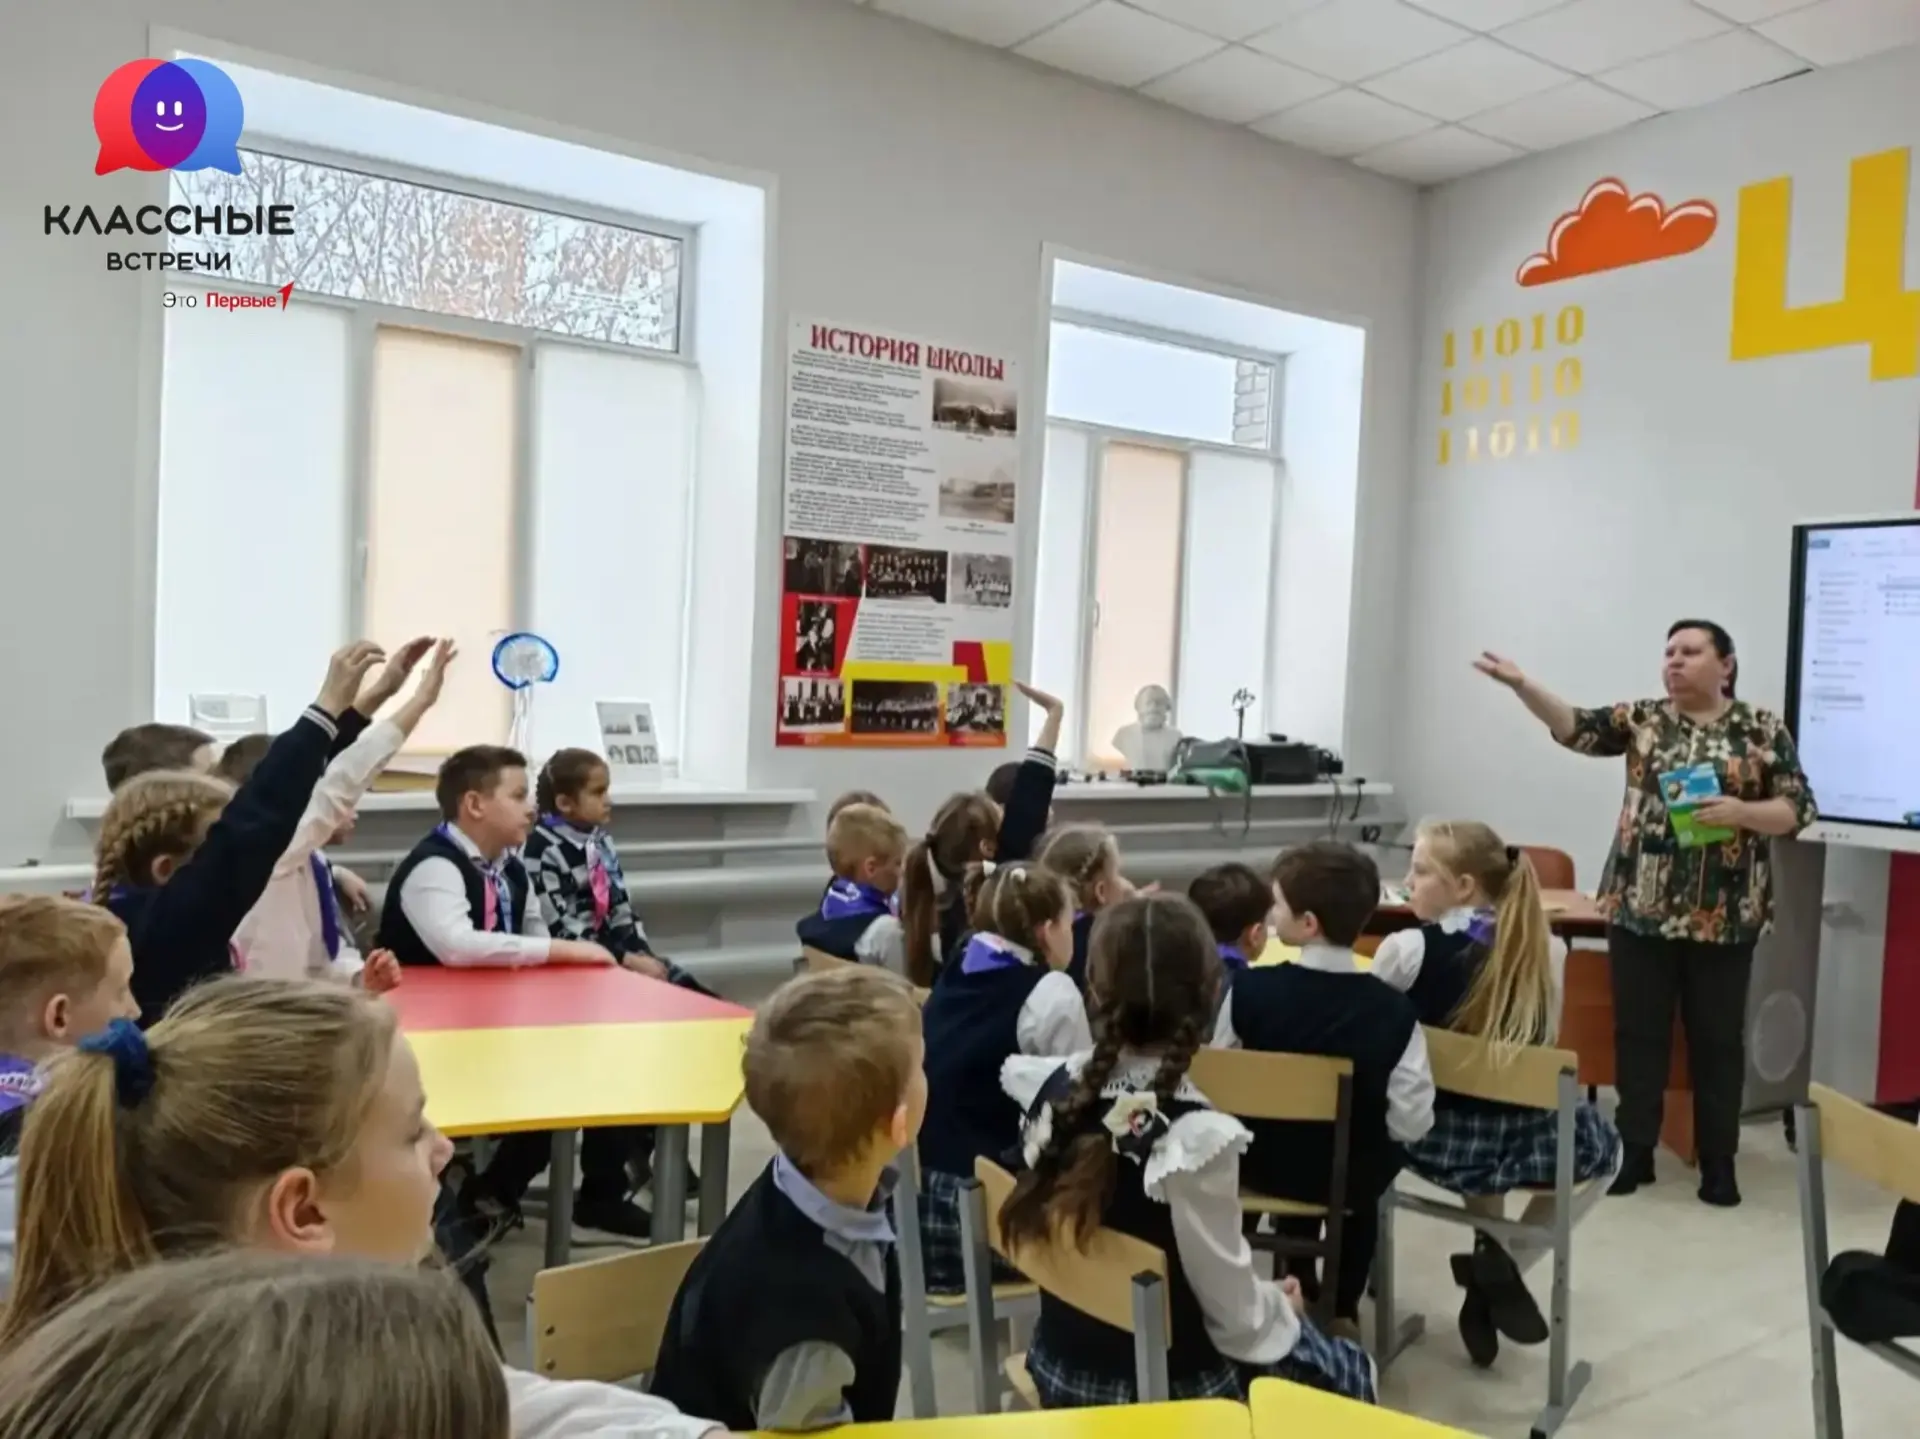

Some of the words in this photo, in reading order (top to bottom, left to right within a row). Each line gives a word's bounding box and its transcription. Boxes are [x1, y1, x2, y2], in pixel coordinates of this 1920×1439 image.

[810, 323, 921, 367] ИСТОРИЯ
[926, 345, 1005, 381] ШКОЛЫ
[1443, 305, 1585, 368] 11010
[1437, 410, 1580, 466] 11010
